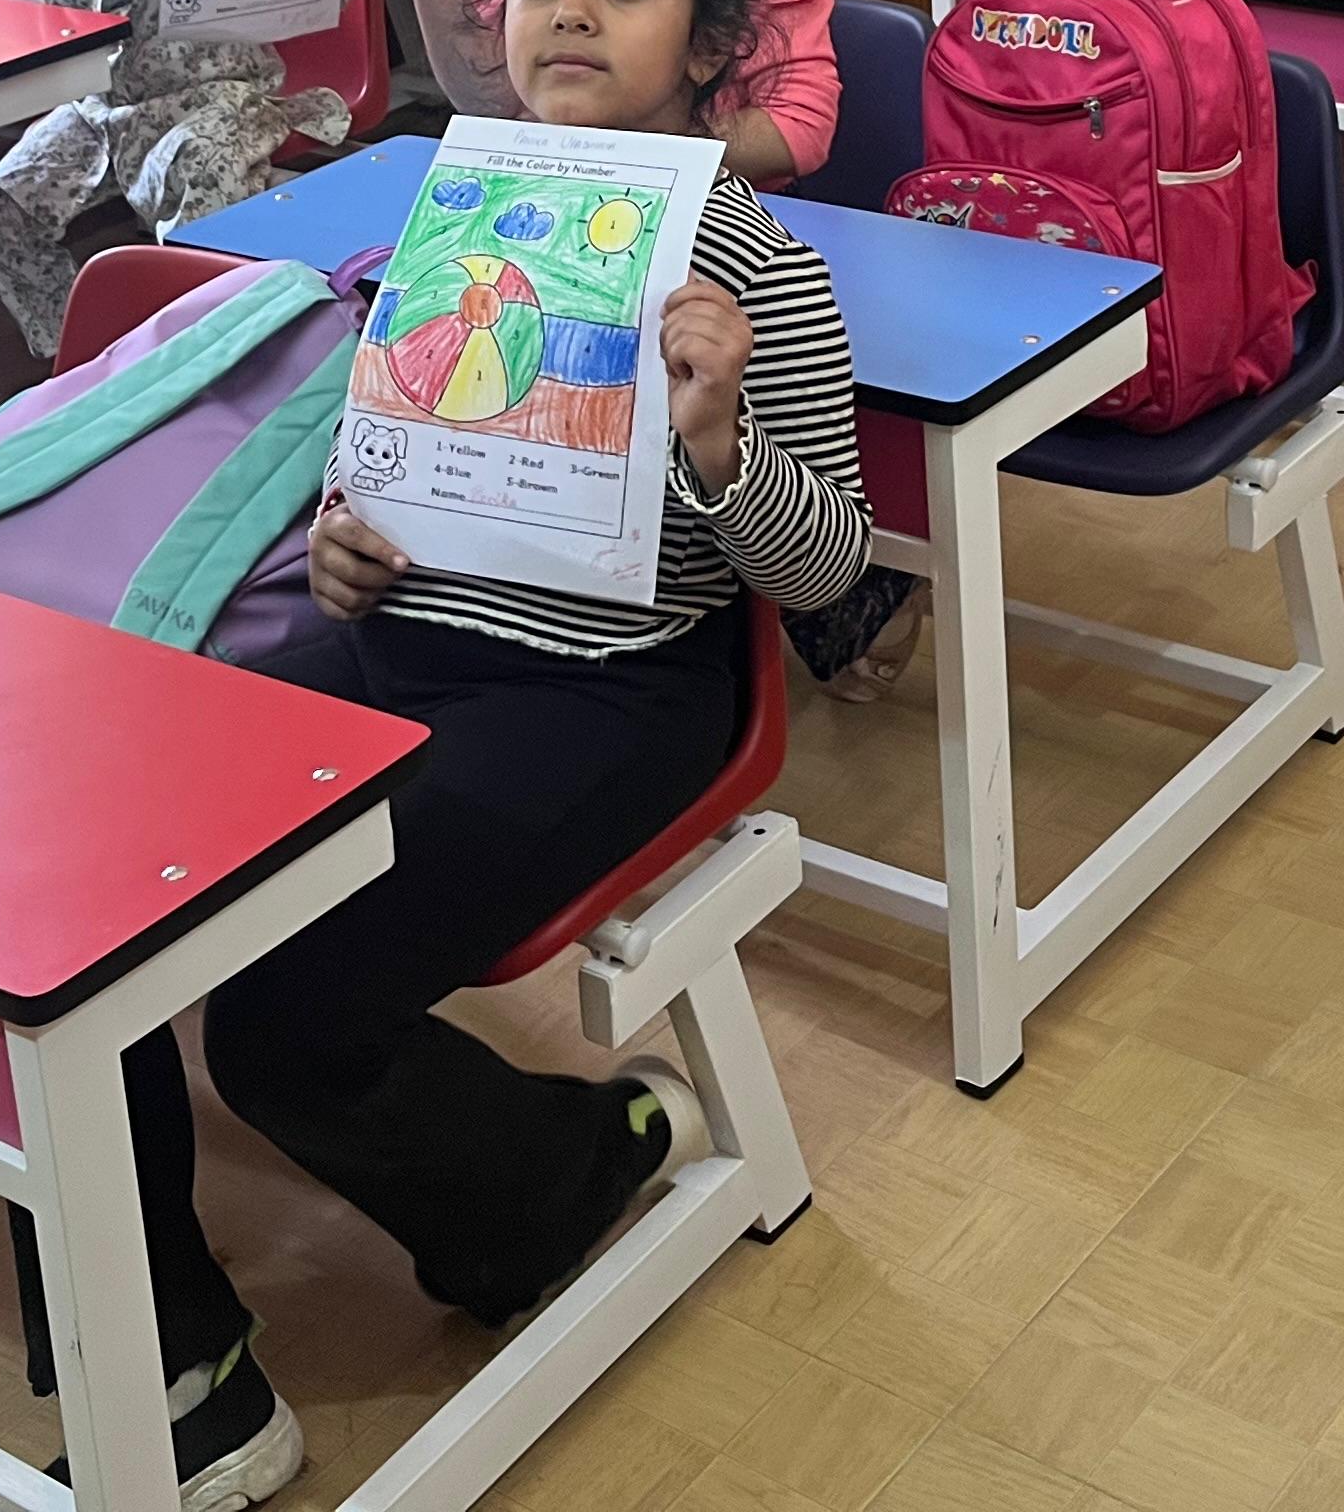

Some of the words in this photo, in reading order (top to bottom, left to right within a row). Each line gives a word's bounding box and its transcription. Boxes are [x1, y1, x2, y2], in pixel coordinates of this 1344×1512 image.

[486, 155, 505, 165] Fill
[506, 157, 524, 168] the
[526, 159, 555, 171] Color
[557, 162, 571, 176] by
[573, 164, 616, 177] Number
[426, 348, 434, 359] 2
[476, 370, 483, 381] 1
[436, 441, 487, 459] 1-Yellow
[508, 454, 545, 469] 2-Red
[569, 463, 620, 481] 3-Green
[433, 463, 472, 479] 4-Blue
[506, 476, 558, 494] 5-Brown
